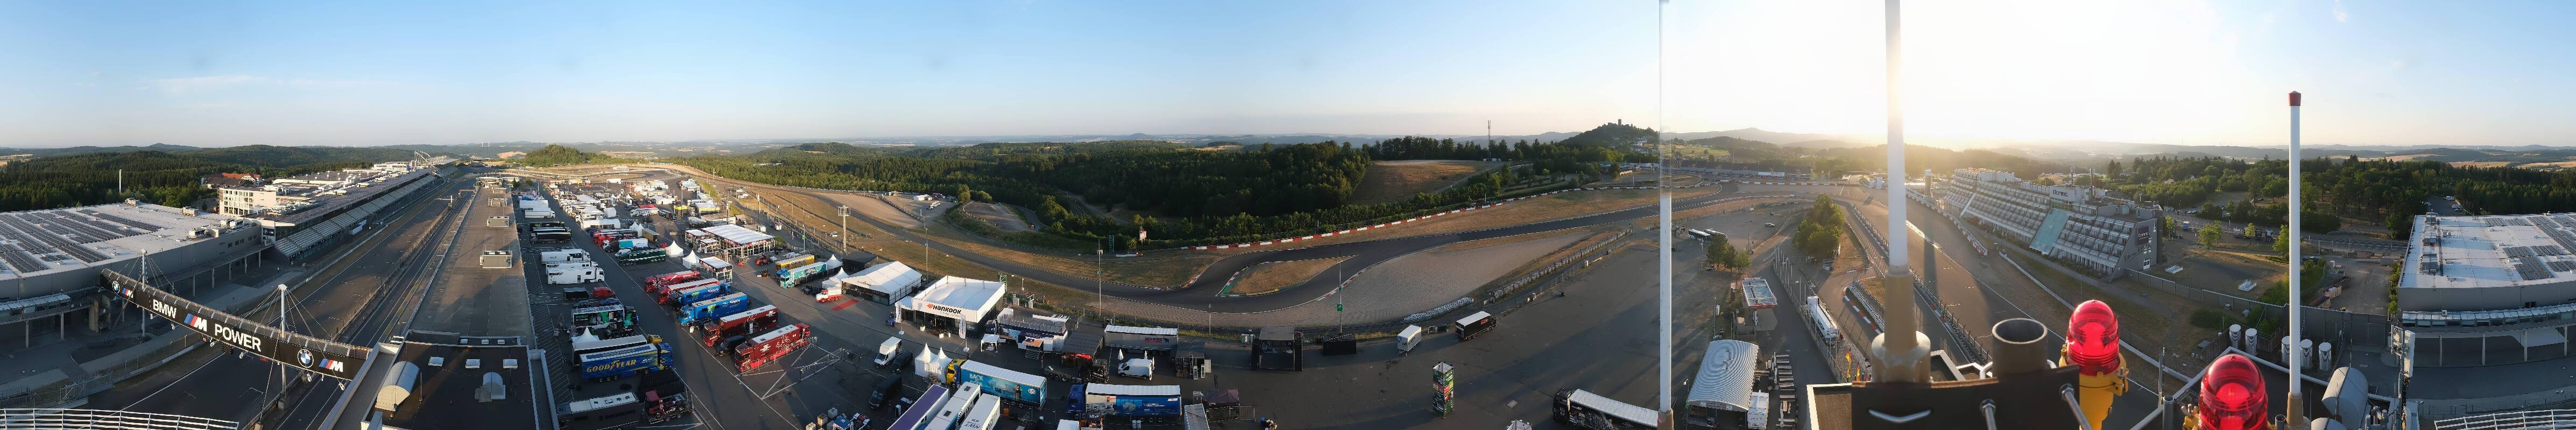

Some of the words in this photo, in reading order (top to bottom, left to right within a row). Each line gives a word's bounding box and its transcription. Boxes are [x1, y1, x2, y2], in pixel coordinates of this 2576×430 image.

[153, 299, 177, 319] BMW
[193, 317, 207, 332] M
[215, 323, 262, 352] POWER
[329, 360, 343, 372] M
[586, 359, 637, 373] GOODYEAR
